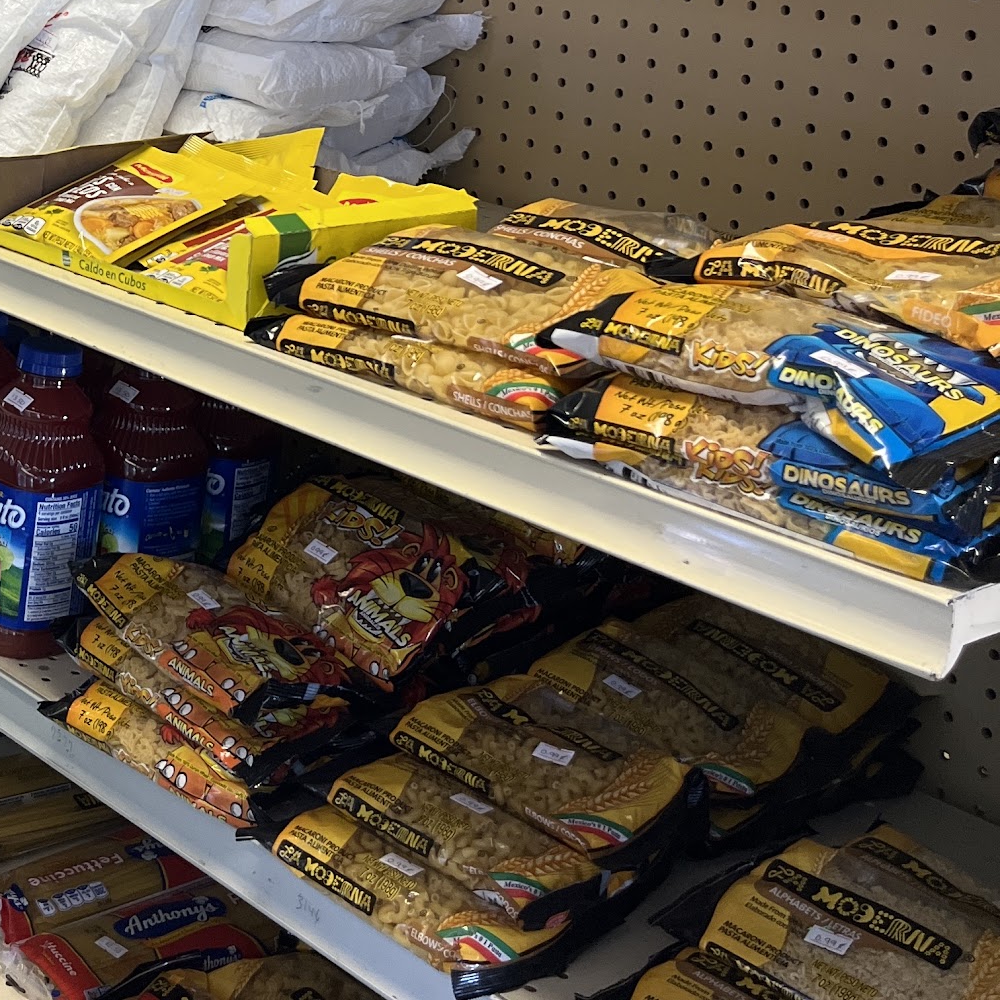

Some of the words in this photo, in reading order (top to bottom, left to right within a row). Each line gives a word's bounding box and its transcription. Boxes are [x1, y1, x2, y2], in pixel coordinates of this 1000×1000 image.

[532, 229, 586, 250] CONCHAS
[827, 221, 1000, 257] MODERNA
[405, 250, 457, 267] CONCHAS
[412, 239, 554, 285] MODERNA
[78, 258, 104, 278] Caldo
[105, 270, 117, 281] en
[118, 272, 148, 292] Cubos
[315, 282, 337, 292] PASTA
[332, 308, 411, 335] MODERNA
[911, 305, 953, 329] FIDEO
[603, 321, 681, 353] MODERNA
[310, 348, 390, 380] MODERNA
[834, 328, 965, 401] DINOSAURS
[452, 391, 481, 409] SHELLS
[487, 402, 534, 421] CONCHAS
[593, 420, 672, 452] MODERNA
[783, 464, 911, 507] DINOSAURS
[38, 501, 64, 512] Nutrition
[64, 500, 82, 510] Facts
[788, 492, 923, 544] DINOSAURS
[36, 527, 62, 537] Calories
[68, 523, 78, 533] 50
[348, 589, 411, 648] ANIMALS
[168, 657, 215, 697] ANIMALS
[165, 712, 215, 751] ANIMALS
[417, 744, 488, 794] MODERNA
[288, 830, 309, 845] PASTA
[295, 825, 327, 846] MACARONI
[356, 805, 431, 855] MODERNA
[28, 852, 125, 887] Fettuccine
[304, 856, 373, 913] MODERNA
[768, 886, 822, 922] ALPHABETS
[827, 919, 863, 942] LETRAS
[811, 886, 952, 966] MODERNA
[410, 928, 442, 951] ELBOWS
[717, 926, 742, 944] PASTA
[722, 920, 765, 945] MACARONI
